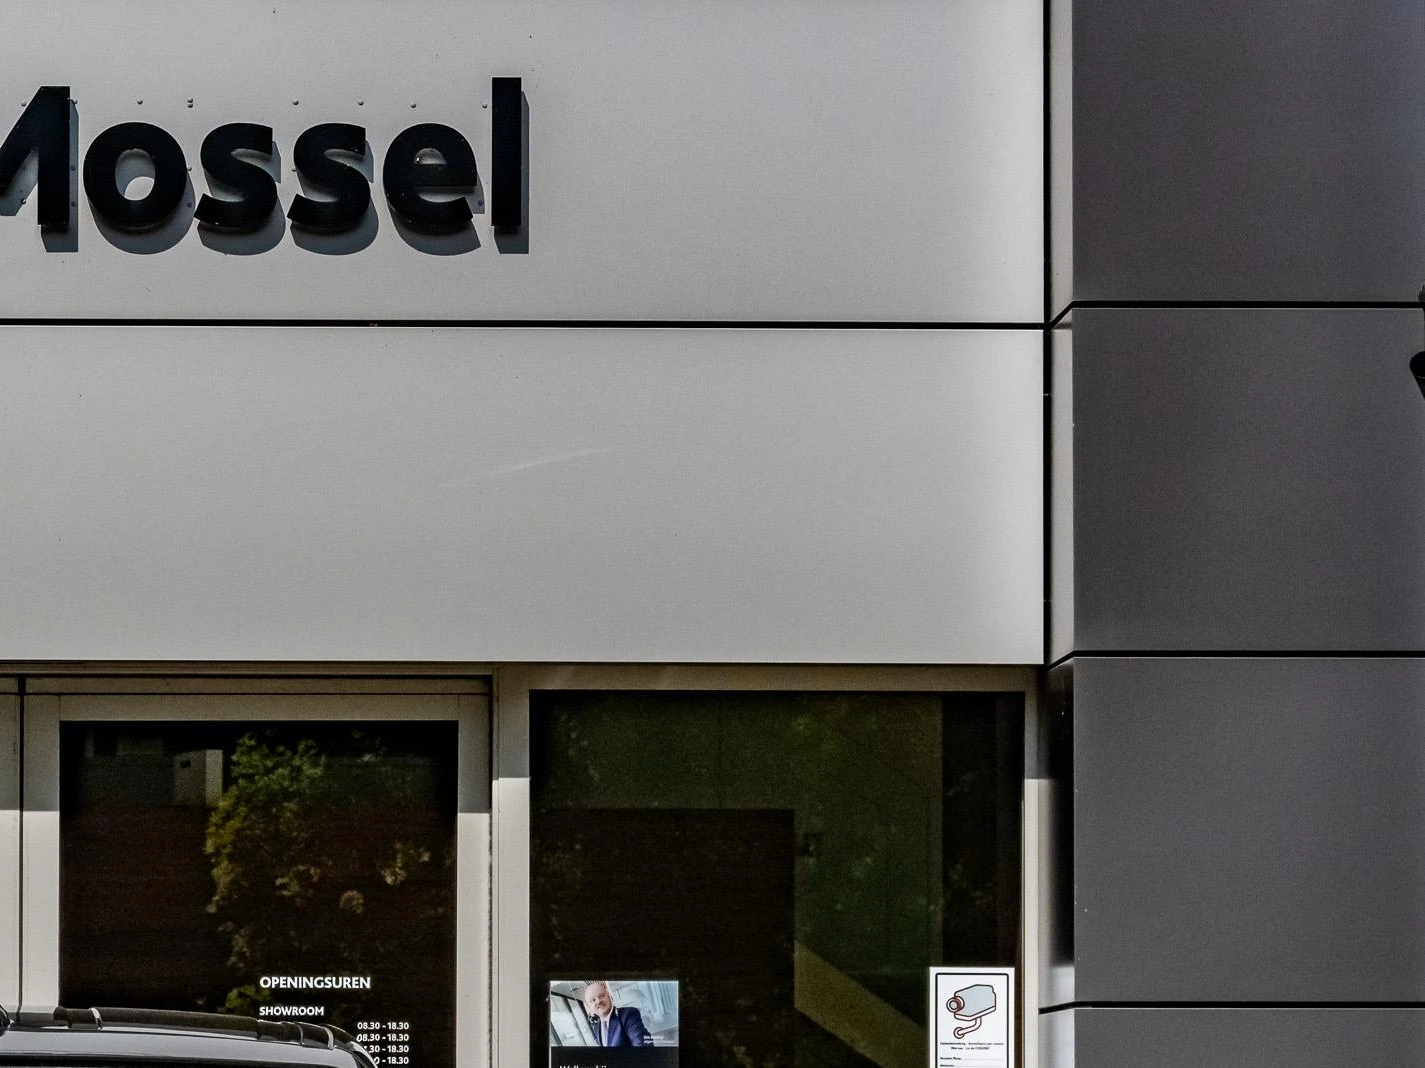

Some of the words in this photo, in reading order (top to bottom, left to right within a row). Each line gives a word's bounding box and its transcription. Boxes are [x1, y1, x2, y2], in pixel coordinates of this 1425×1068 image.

[259, 976, 372, 989] OPENINGSUREN
[259, 1006, 325, 1016] SHOWROOM
[357, 1022, 380, 1030] 08.30
[387, 1022, 409, 1030] 18.30
[356, 1033, 380, 1042] 08.30
[387, 1033, 409, 1042] 18.30
[387, 1045, 409, 1053] 18.30
[387, 1056, 409, 1065] 18.30
